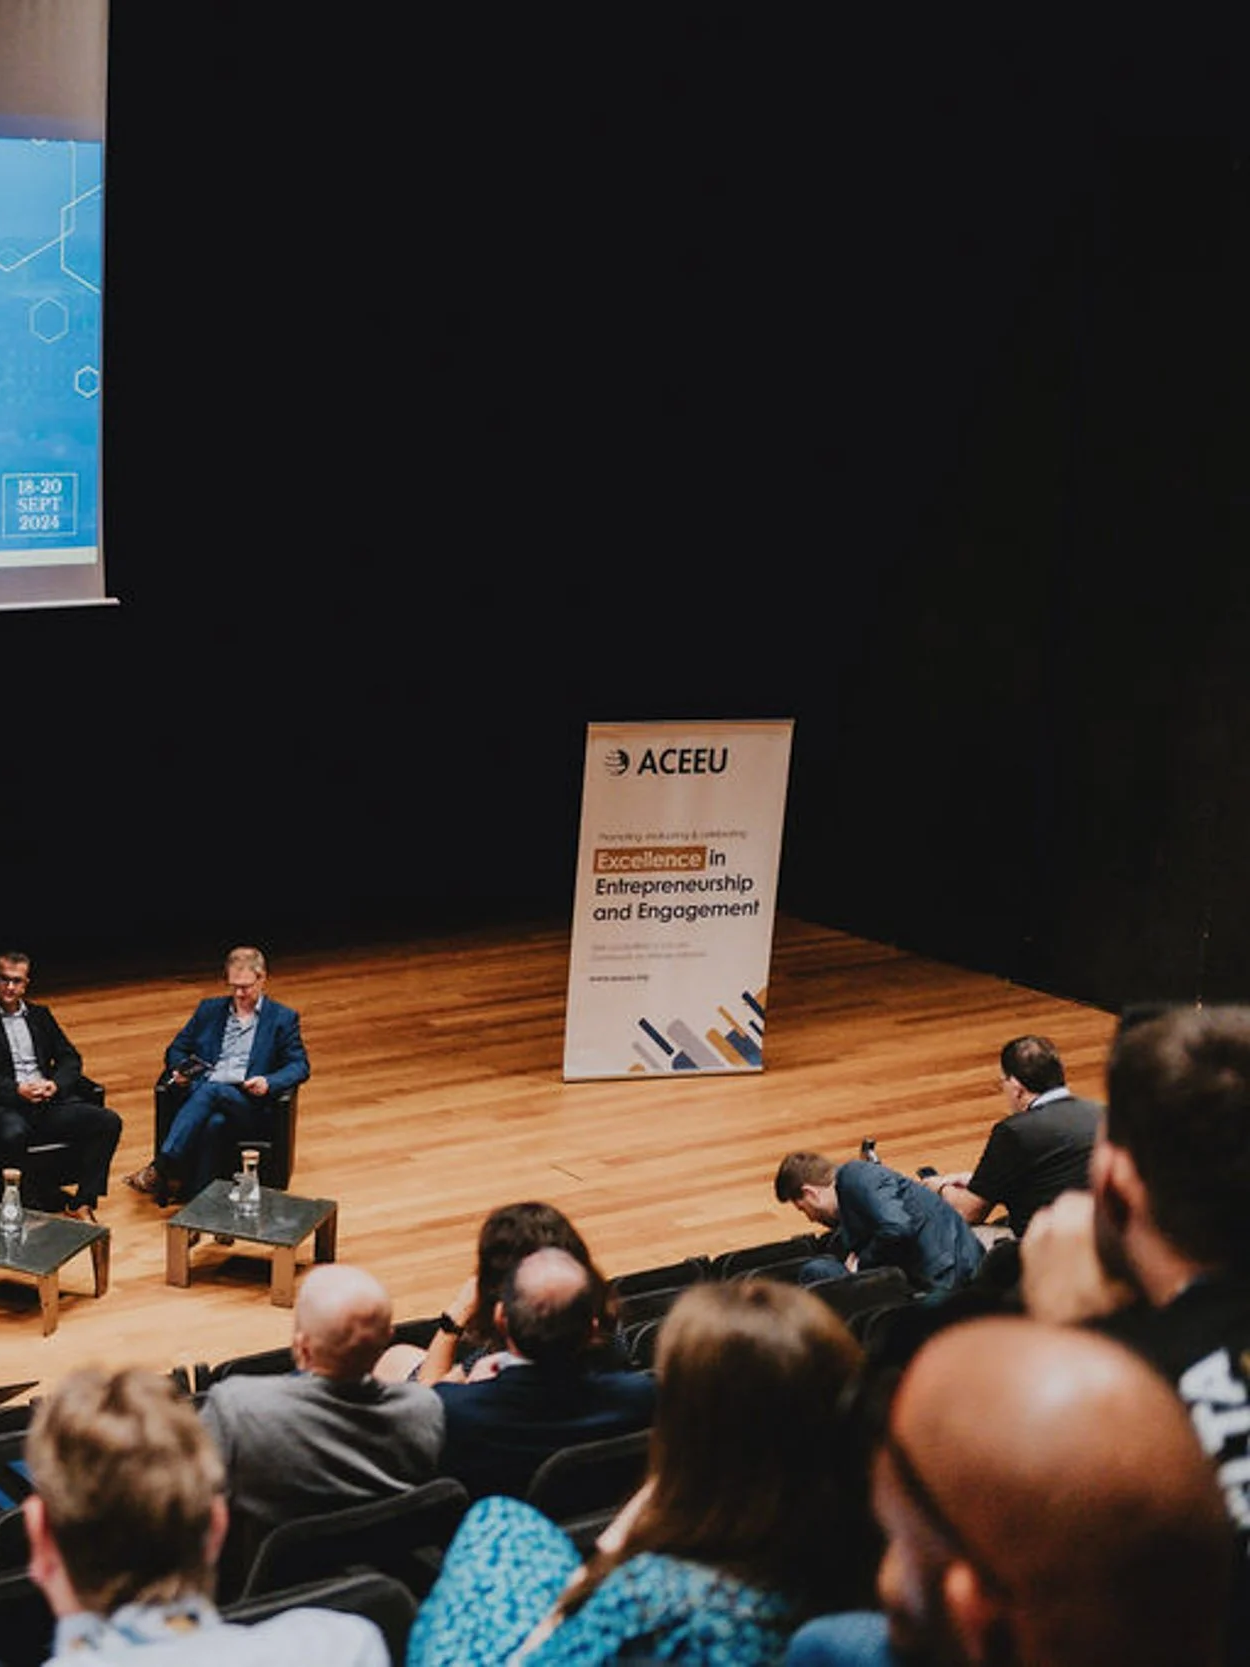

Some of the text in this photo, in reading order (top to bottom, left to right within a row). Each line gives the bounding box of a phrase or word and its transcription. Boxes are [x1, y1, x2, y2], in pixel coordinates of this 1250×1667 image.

[17, 478, 63, 495] 18-20
[16, 495, 63, 513] SEPT
[17, 514, 60, 531] 2024
[637, 748, 728, 775] ACEEU
[596, 848, 726, 870] Excellence in
[595, 874, 755, 898] Entrepreneurship
[593, 899, 761, 923] and Engagement
